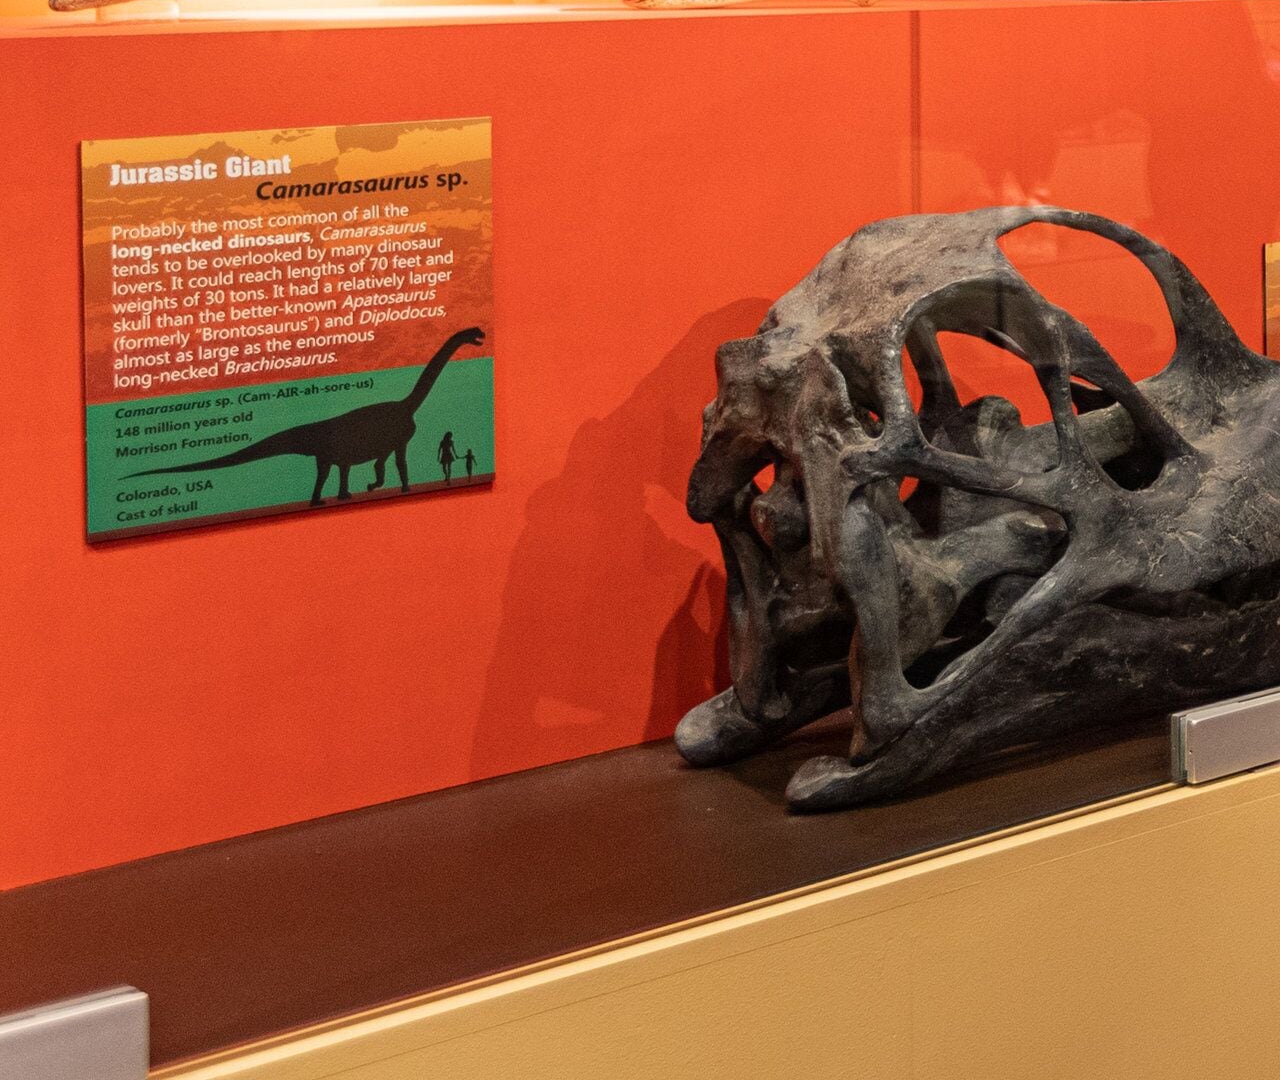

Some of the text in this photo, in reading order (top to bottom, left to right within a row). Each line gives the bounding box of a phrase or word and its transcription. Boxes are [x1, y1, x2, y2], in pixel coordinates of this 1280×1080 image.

[110, 155, 291, 186] Jurassic Giant
[254, 173, 468, 201] Camarasaurus sp.
[111, 204, 409, 240] Probably the most common of all the
[112, 222, 427, 260] long-necked dinosaurs, Camarasaurus
[112, 238, 443, 277] tends to be overlooked by many dinosaur
[112, 250, 454, 296] lovers. It could reach lengths of 70 feet and
[112, 271, 452, 315] weights of 30 tons. It had a relatively larger
[114, 290, 436, 333] skull than the better-known Apatosaurus
[114, 330, 190, 353] (formerly
[324, 312, 353, 328] and
[359, 306, 447, 326] Diplodocus,
[114, 331, 375, 370] almost as large as the enormous
[114, 352, 338, 389] long-necked Brachiosaurus.
[115, 378, 374, 419] Camarasaurus sp. (Cam-AIR-ah-sore-us)
[116, 411, 253, 439] 148 million years old
[116, 432, 253, 458] Morrison Formation,
[116, 480, 214, 503] Colorado, USA
[116, 501, 198, 522] Cast of skull
